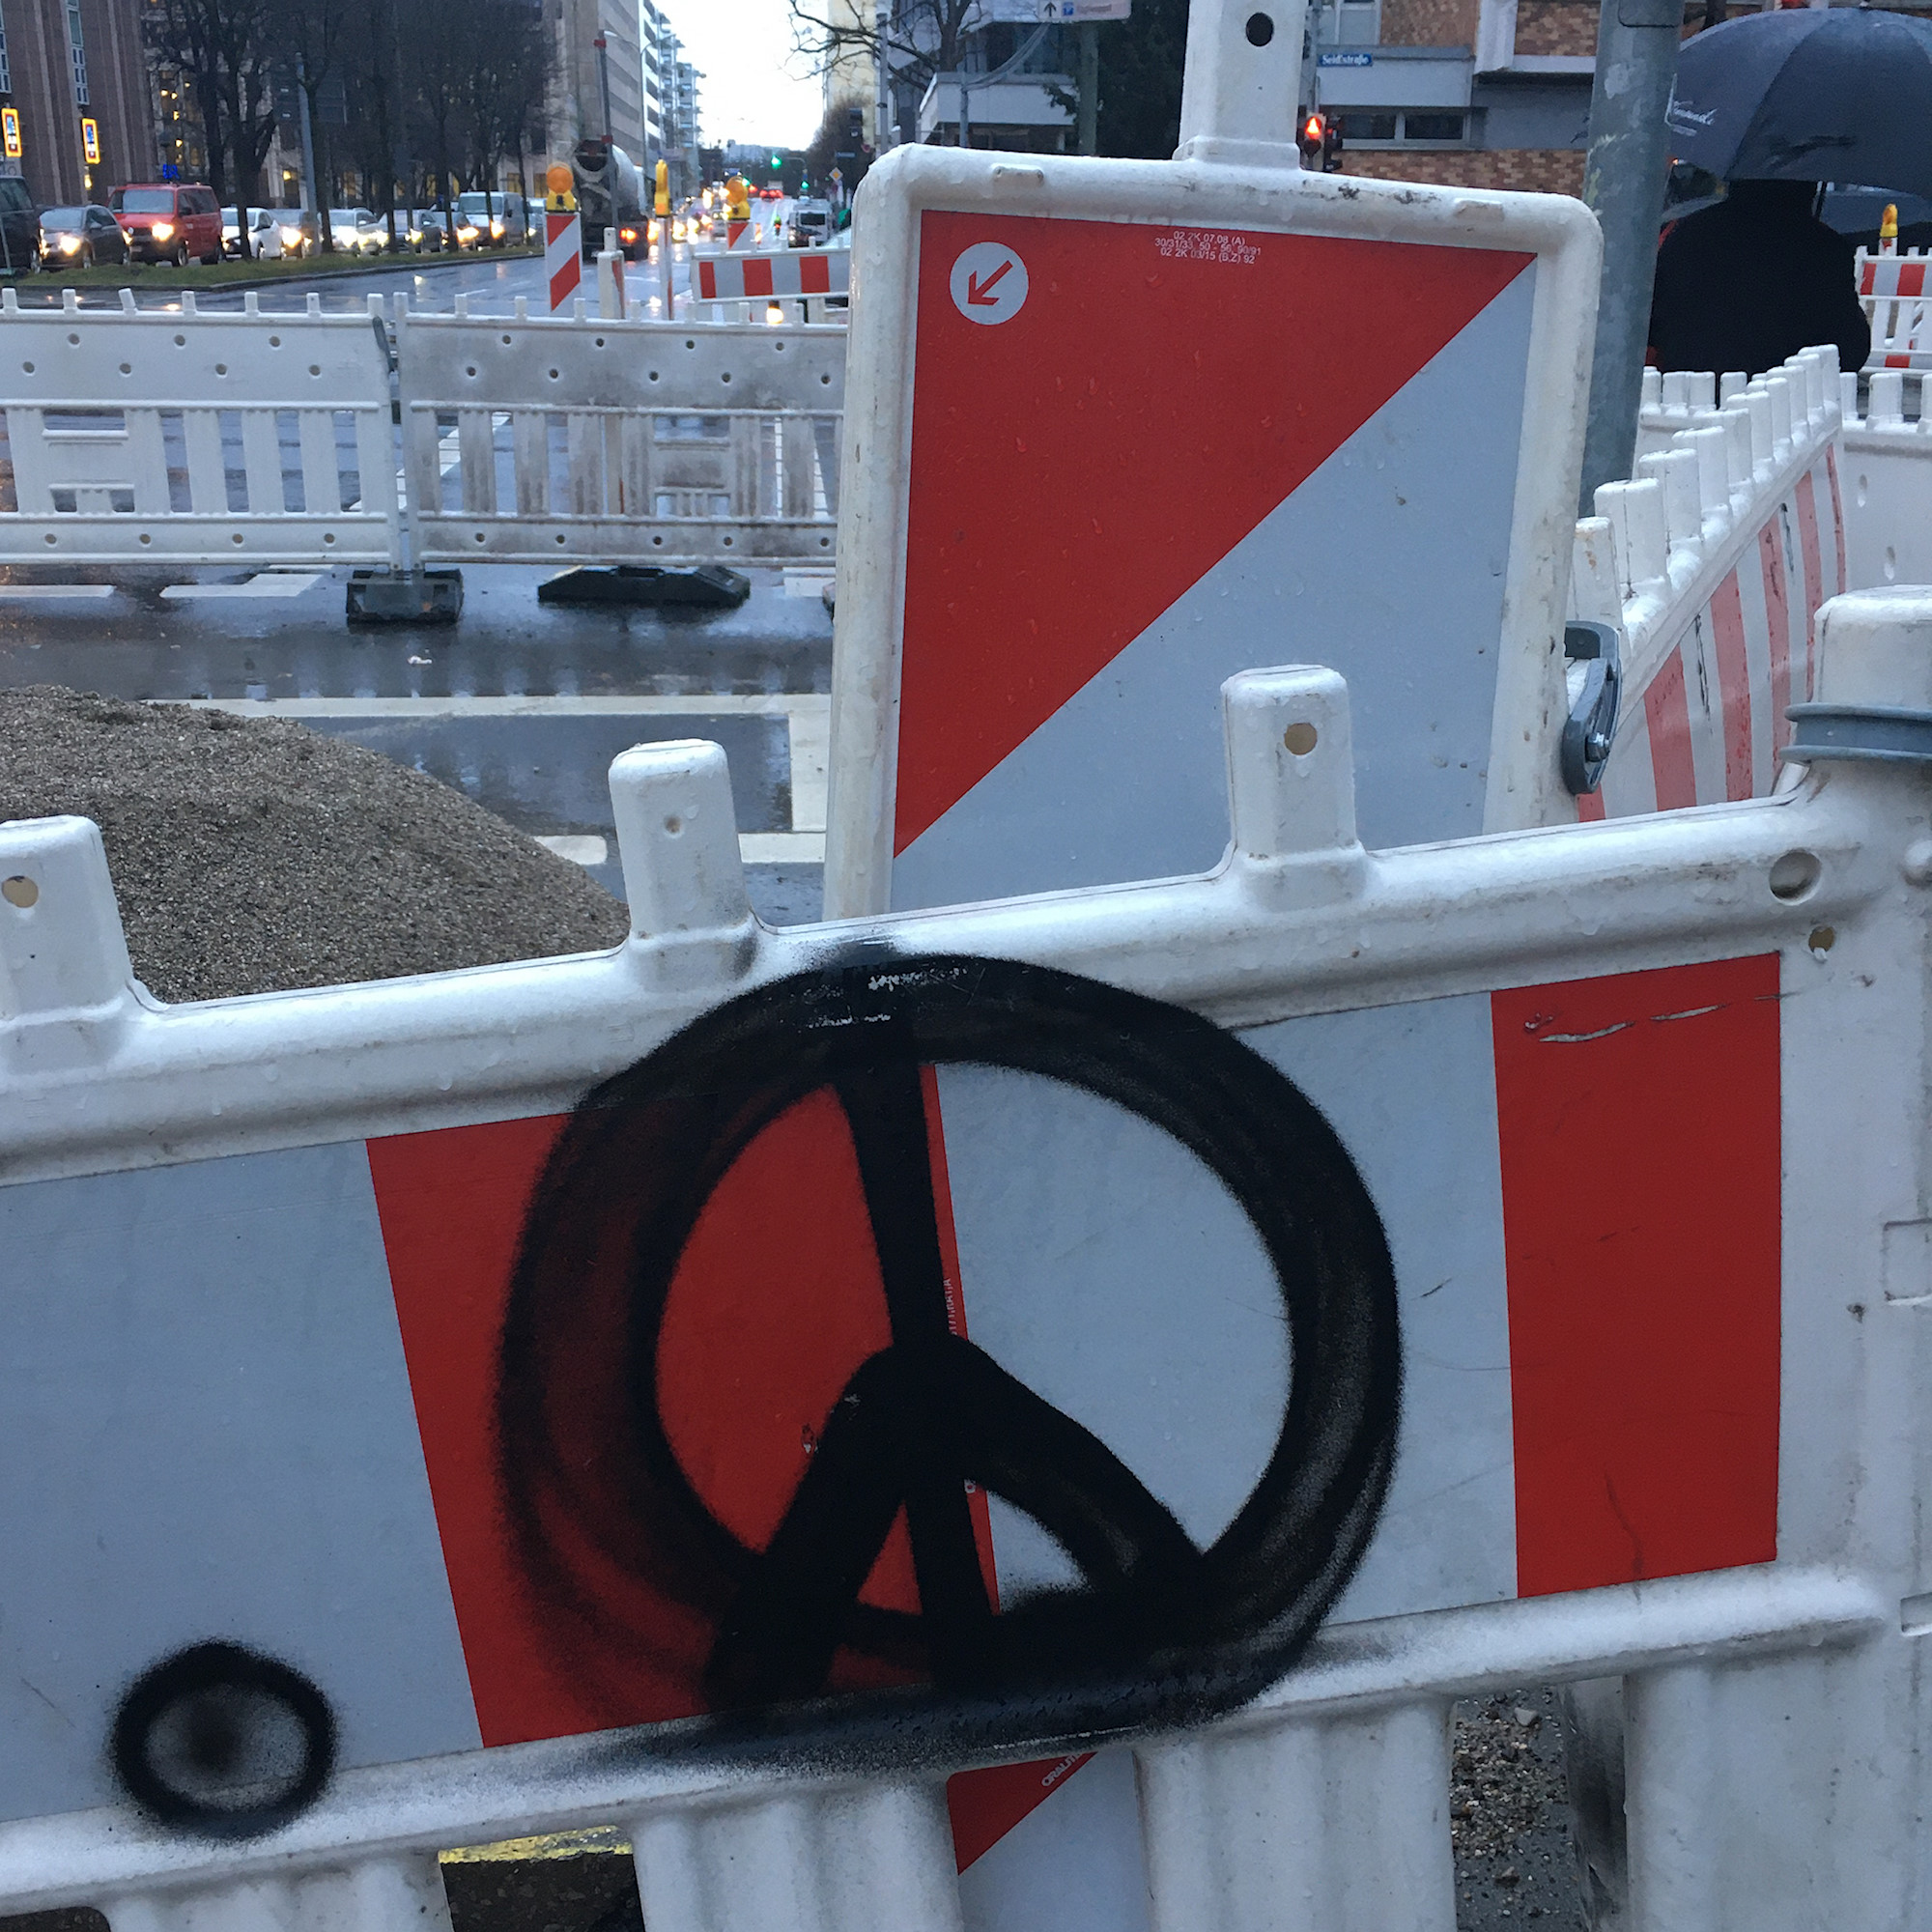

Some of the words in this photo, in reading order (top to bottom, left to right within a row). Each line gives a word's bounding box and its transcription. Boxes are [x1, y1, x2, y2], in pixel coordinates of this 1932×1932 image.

[1173, 230, 1185, 241] 02
[1231, 236, 1246, 246] (A)
[1160, 246, 1172, 257] 02
[1175, 248, 1188, 258] 2K
[1190, 249, 1216, 261] 03/15
[1243, 254, 1256, 265] 92
[1199, 242, 1211, 251] 50
[1237, 244, 1262, 256] 90/91
